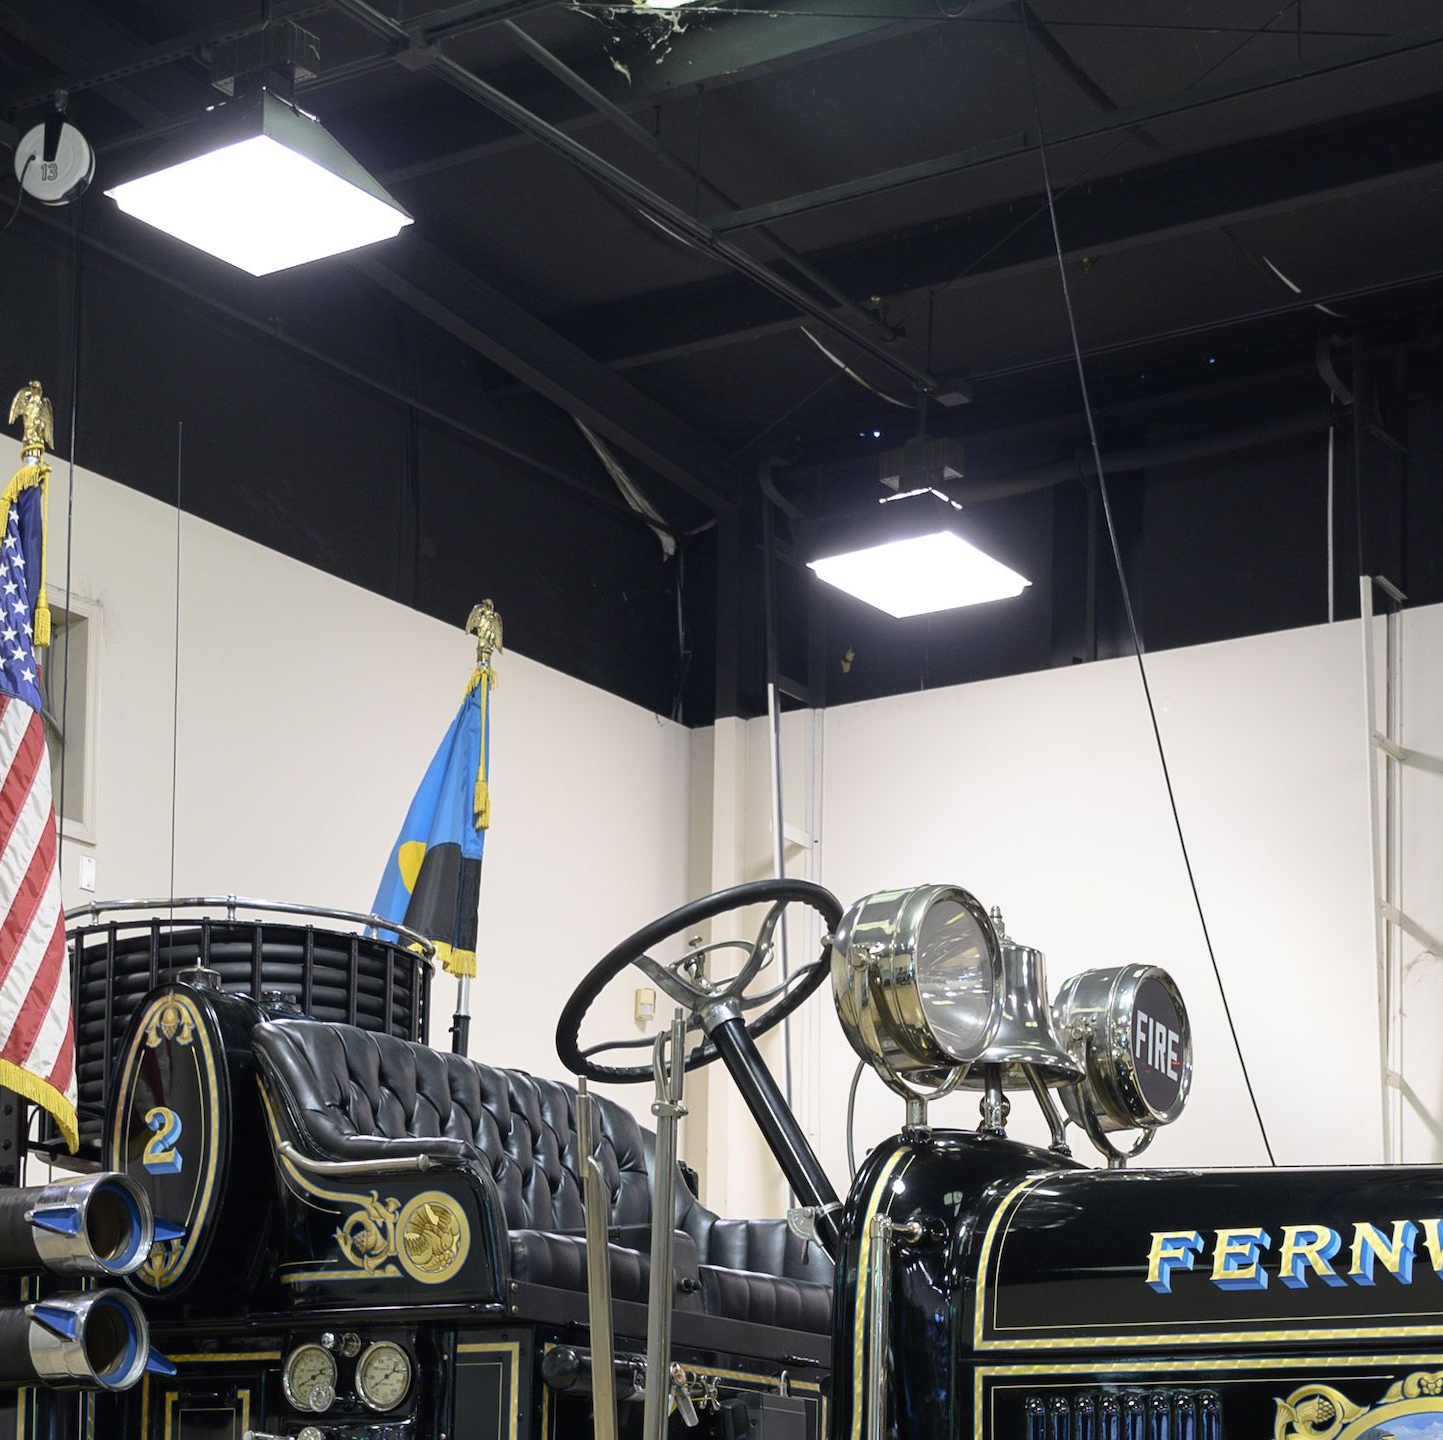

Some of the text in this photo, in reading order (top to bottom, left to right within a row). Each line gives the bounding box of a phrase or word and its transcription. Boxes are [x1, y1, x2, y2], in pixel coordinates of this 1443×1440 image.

[42, 164, 58, 181] 13
[1134, 1009, 1180, 1082] FIRE
[142, 1106, 183, 1175] 2
